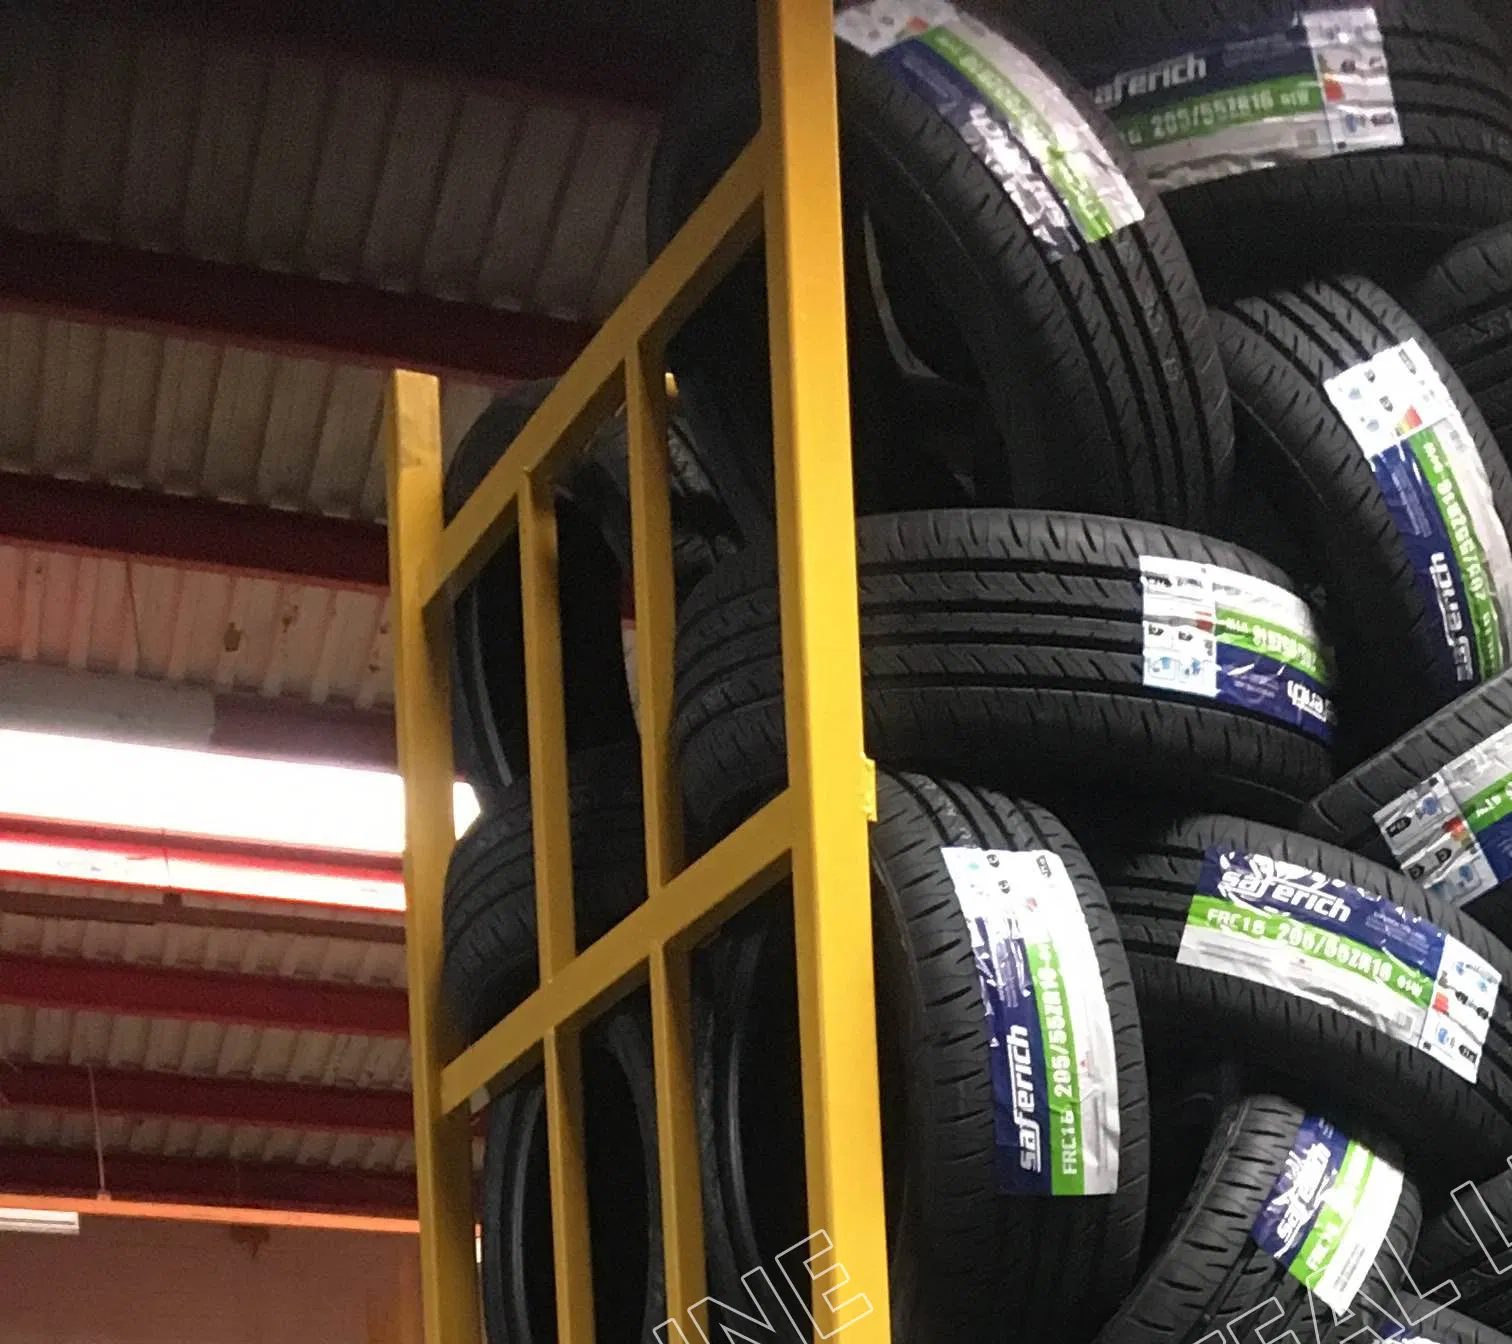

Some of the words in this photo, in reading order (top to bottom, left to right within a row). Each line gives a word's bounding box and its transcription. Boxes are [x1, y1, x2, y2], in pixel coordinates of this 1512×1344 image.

[1094, 53, 1207, 104] aferich
[1220, 868, 1352, 924] saferich
[1039, 968, 1070, 1097] 205/55ZR16
[1008, 1024, 1040, 1172] saferich
[1061, 1110, 1077, 1175] FRC16
